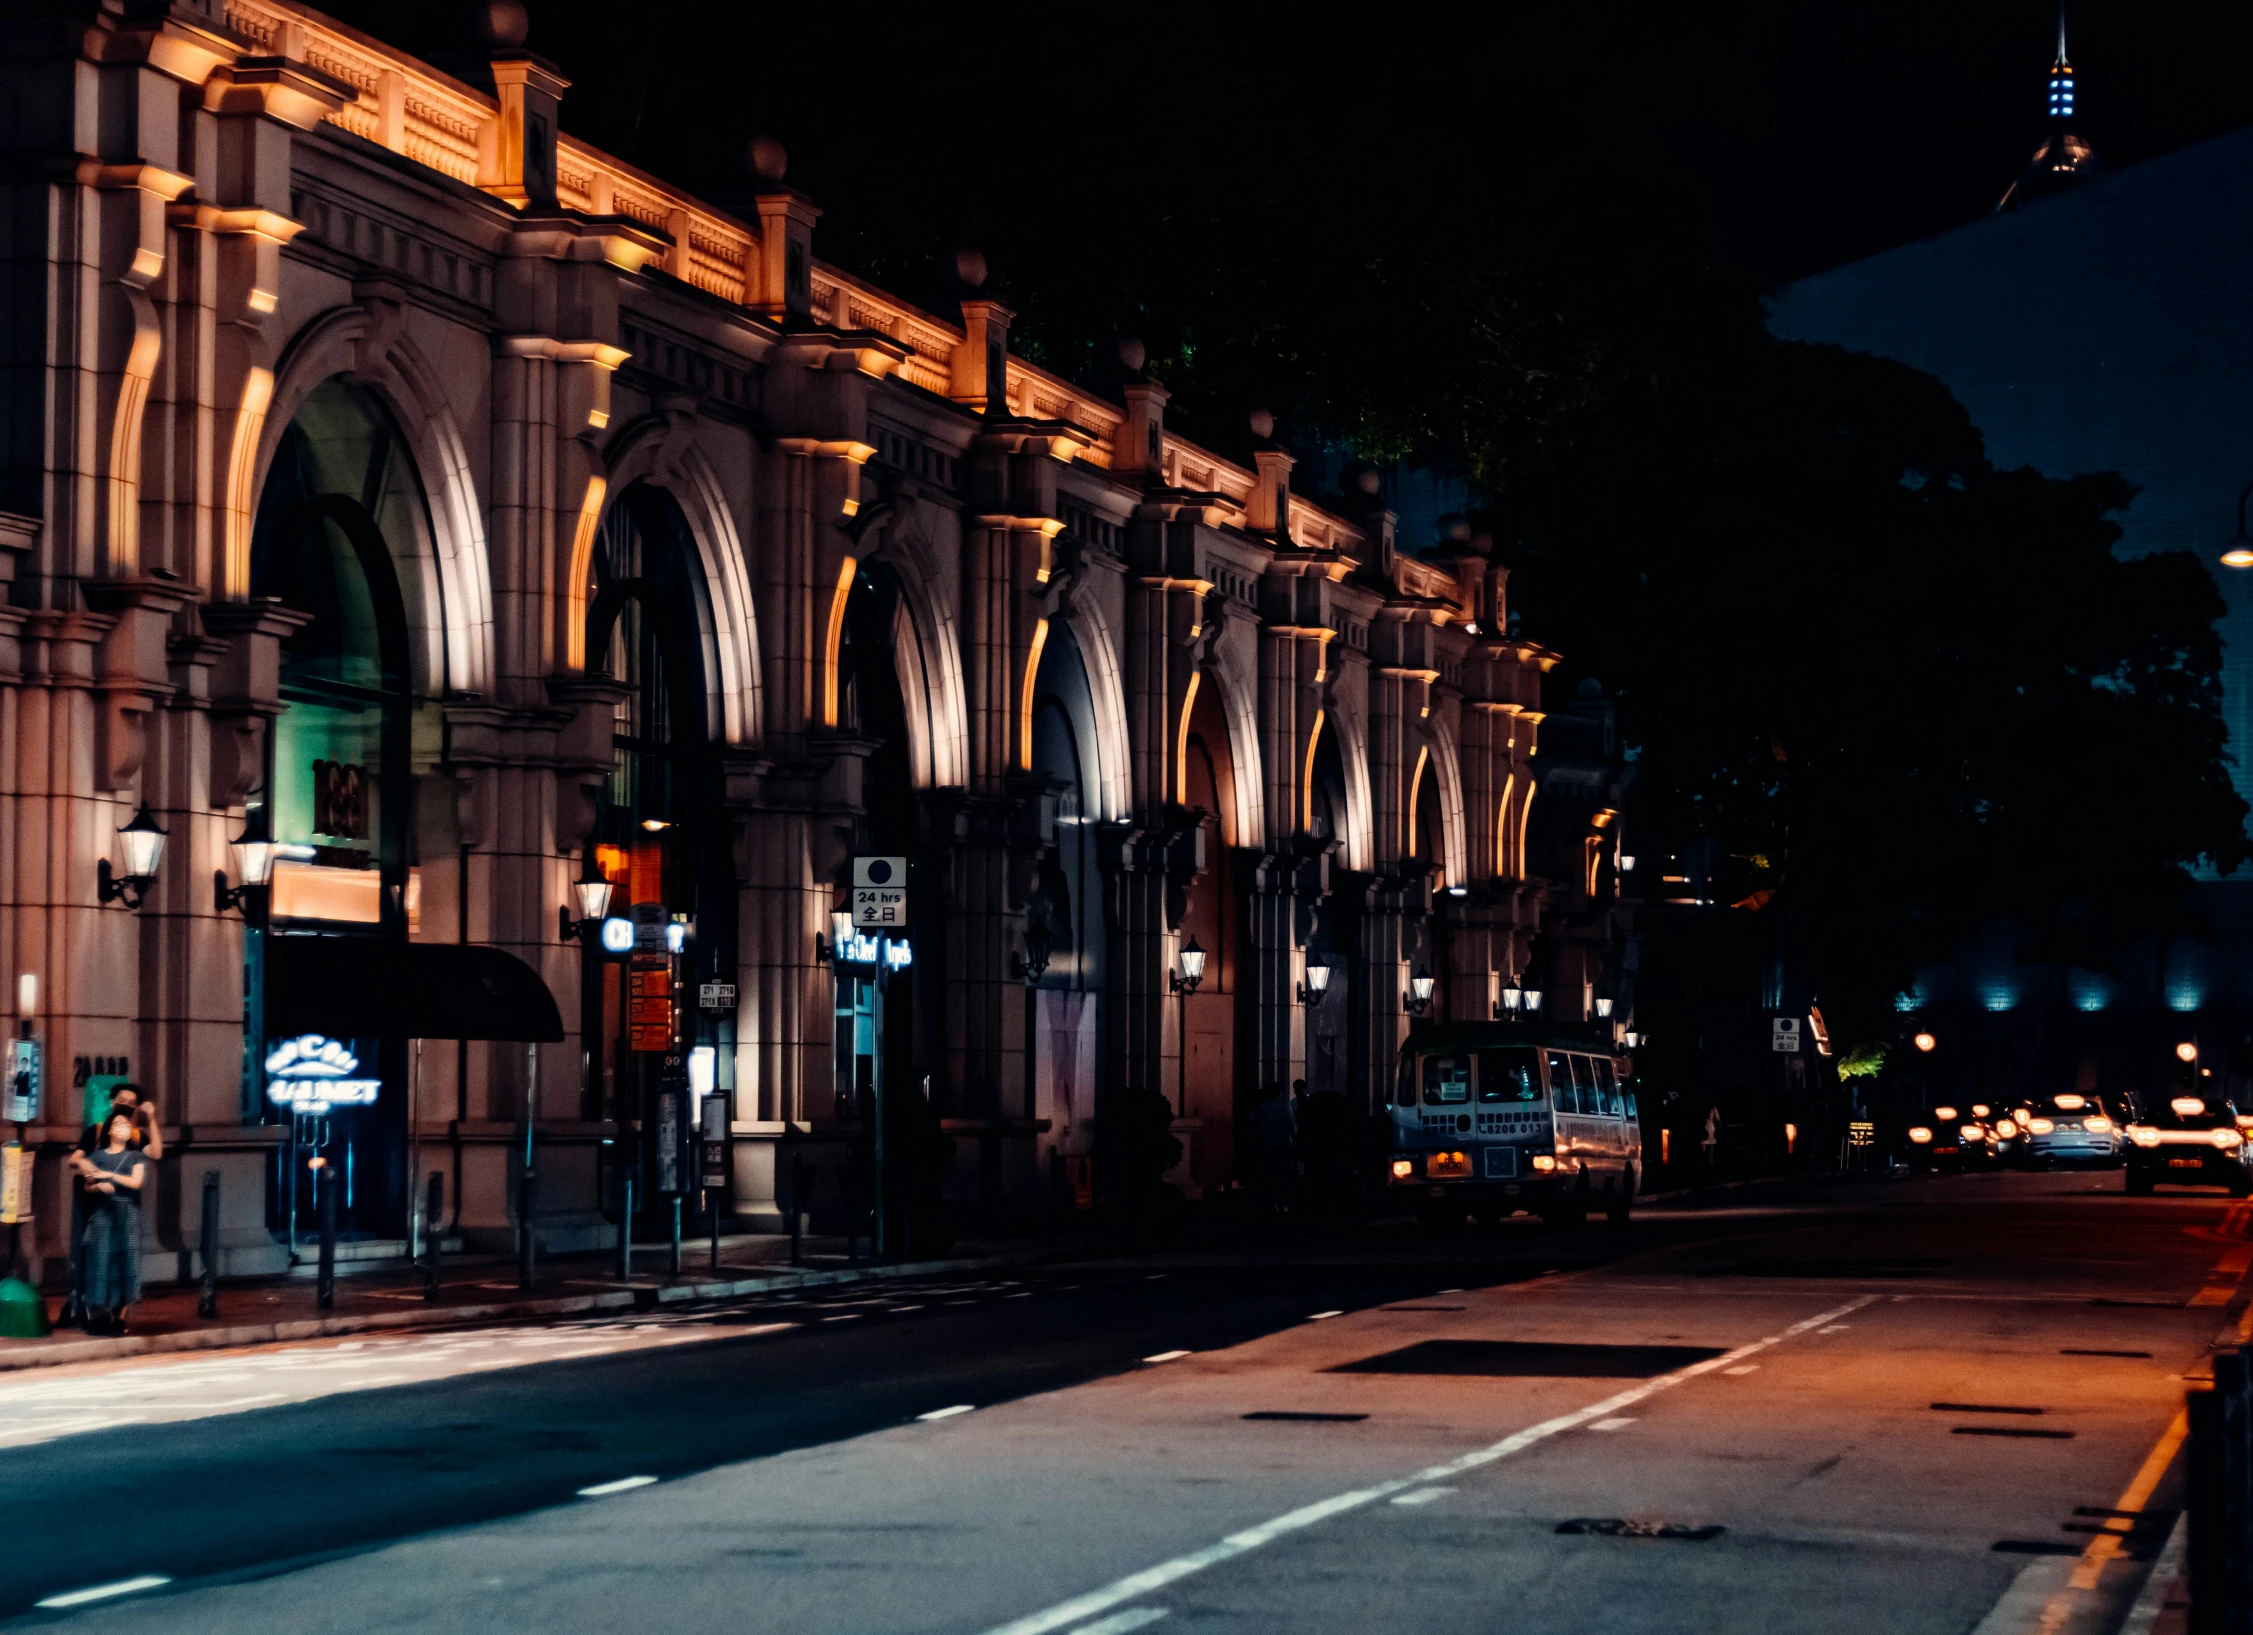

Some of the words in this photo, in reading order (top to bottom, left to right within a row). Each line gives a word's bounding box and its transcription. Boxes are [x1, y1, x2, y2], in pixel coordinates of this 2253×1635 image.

[858, 892, 876, 903] 24
[881, 892, 901, 903] hrs
[862, 906, 895, 922] 全日
[703, 986, 714, 995] 271
[1777, 1041, 1795, 1050] 全日
[1487, 1124, 1516, 1134] 8206
